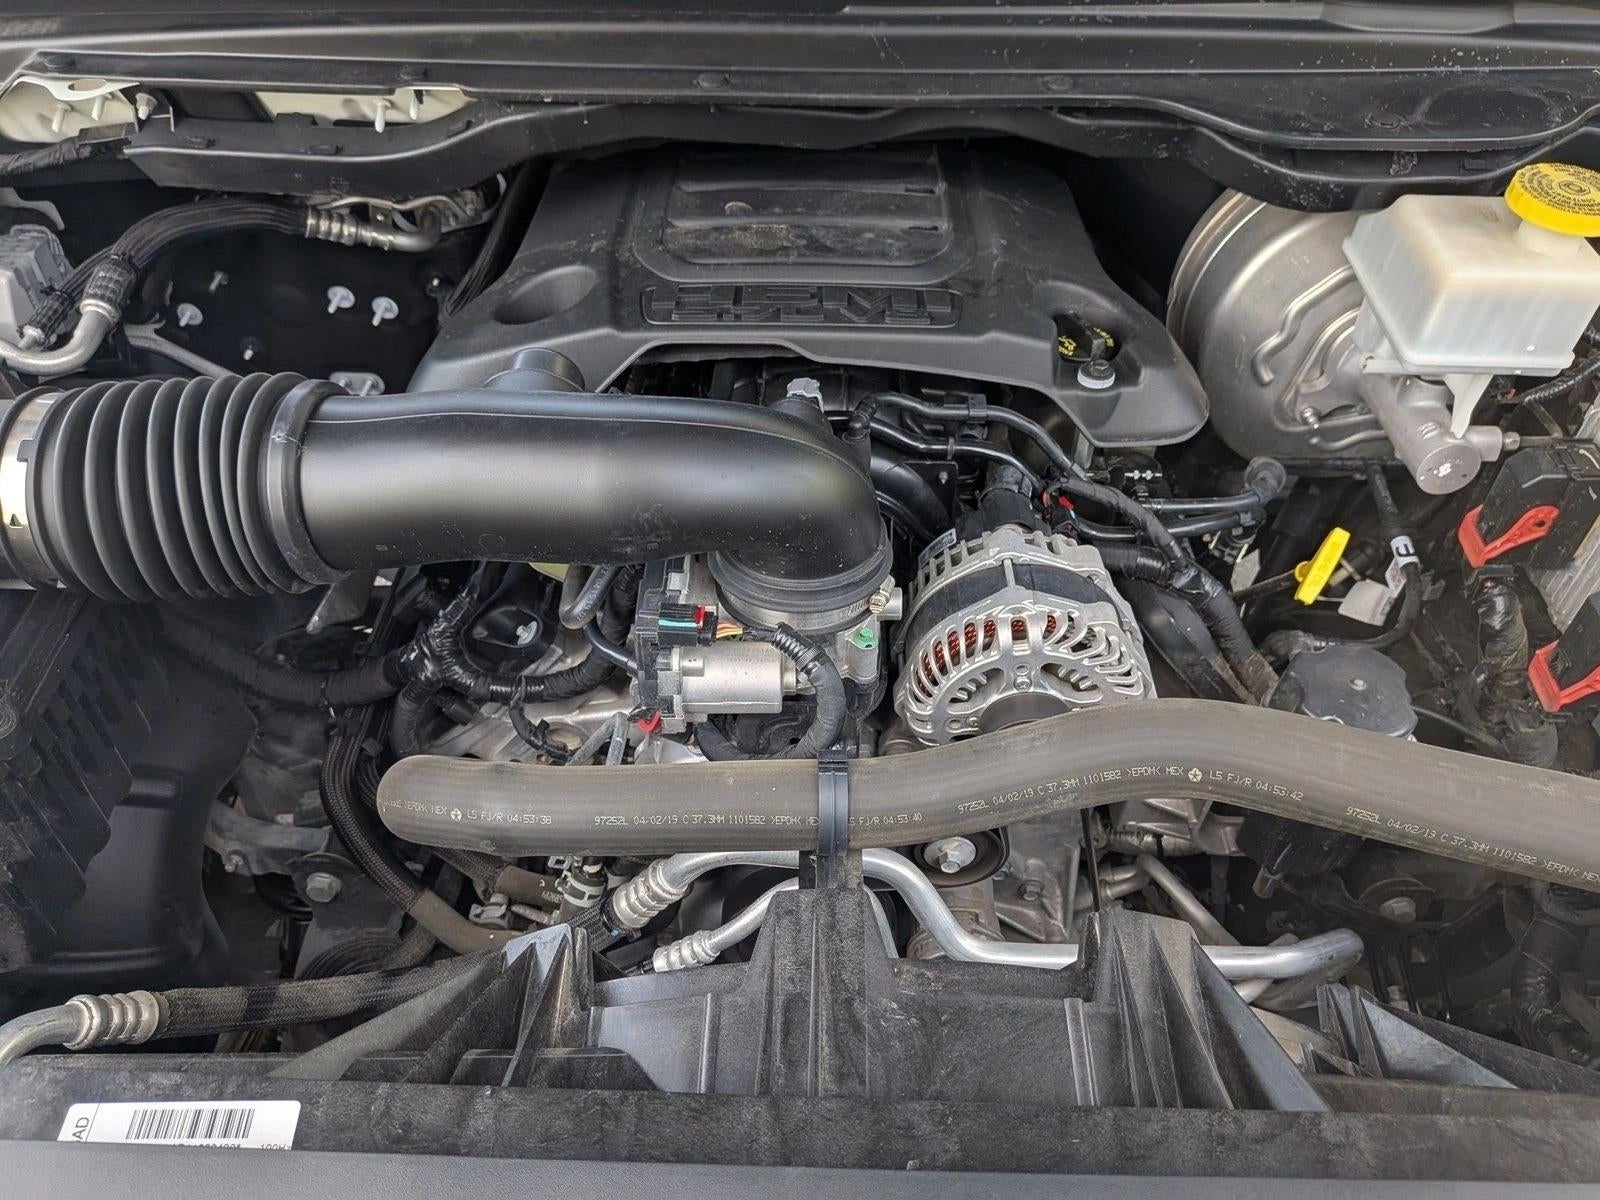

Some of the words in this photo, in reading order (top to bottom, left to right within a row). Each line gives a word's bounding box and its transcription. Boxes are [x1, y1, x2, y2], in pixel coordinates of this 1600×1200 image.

[957, 799, 990, 814] 97252L
[992, 788, 1034, 804] 04/02/19
[1038, 785, 1045, 795] C
[1046, 778, 1080, 793] 37.3MM
[1083, 769, 1122, 785] 1101582
[1165, 766, 1184, 776] MEX
[1256, 780, 1304, 801] 04:53:42
[507, 813, 552, 825] 04:53:38
[595, 815, 629, 826] 97252L
[634, 814, 678, 825] 04/02/19
[683, 815, 689, 824] C
[692, 814, 725, 825] 37.3MM
[729, 814, 766, 825] 1101582
[883, 812, 923, 825] 04:53:40
[1345, 806, 1381, 824] 97252L
[1450, 835, 1490, 853] 37.3MM
[1493, 847, 1538, 866] 1101582
[72, 1116, 90, 1142] AD
